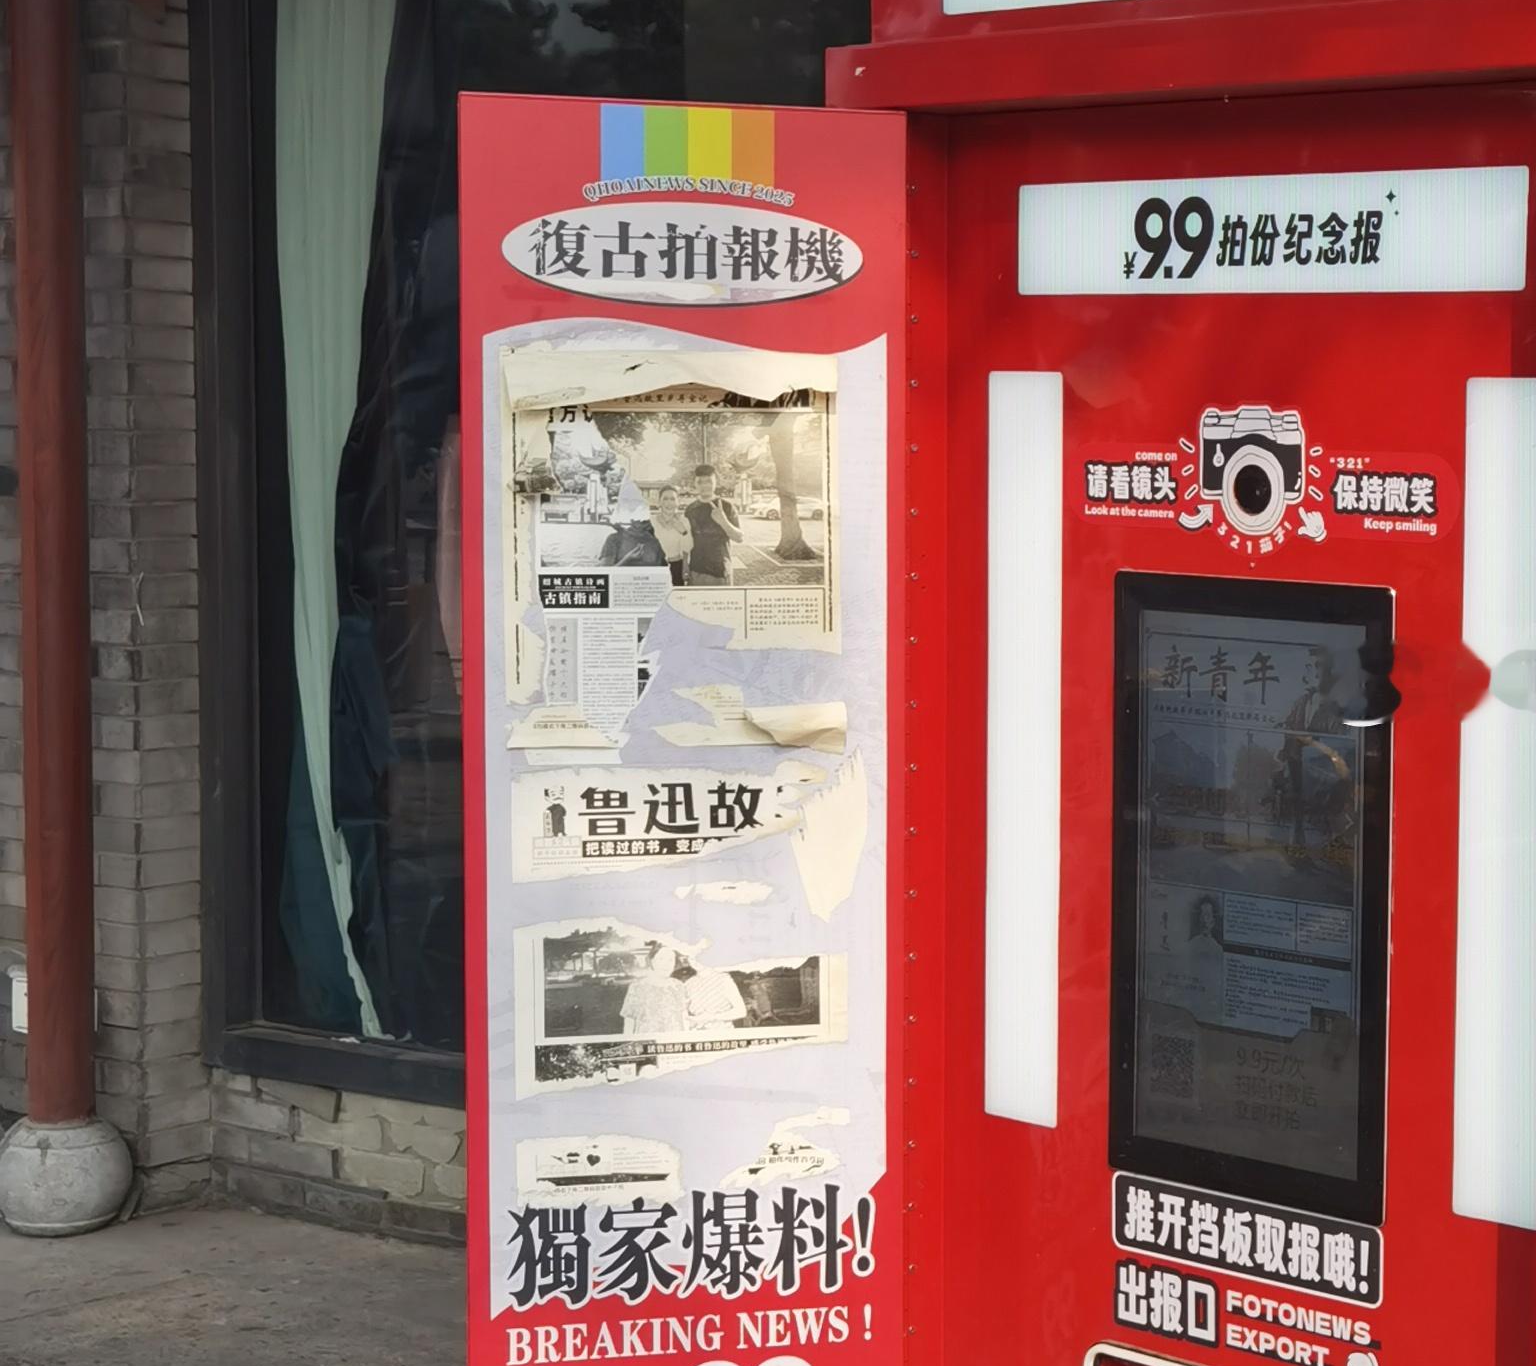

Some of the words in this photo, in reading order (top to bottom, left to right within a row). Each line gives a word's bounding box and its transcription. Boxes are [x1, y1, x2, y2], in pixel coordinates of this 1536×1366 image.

[698, 177, 752, 198] SINCE
[753, 184, 795, 207] 2025
[527, 217, 848, 284] 復古拍報機
[1216, 209, 1384, 270] 拍份纪念报
[1086, 463, 1177, 502] 请看镜头
[1135, 451, 1162, 462] come
[1164, 451, 1178, 462] on
[1084, 504, 1108, 517] Look
[1110, 506, 1119, 517] at
[1121, 506, 1136, 518] the
[1137, 508, 1175, 520] camera
[1332, 474, 1436, 515] 保持微笑
[1363, 517, 1393, 533] Keep
[1395, 520, 1437, 536] smiling
[1161, 643, 1281, 706] 新青年
[578, 779, 783, 837] 鲁迅故
[1124, 1185, 1370, 1294] 推开挡板取报哦!
[1117, 1264, 1215, 1343] 出报口
[1225, 1290, 1371, 1346] FOTONEWS
[506, 1313, 726, 1366] BREAKING
[736, 1305, 850, 1352] NEWS
